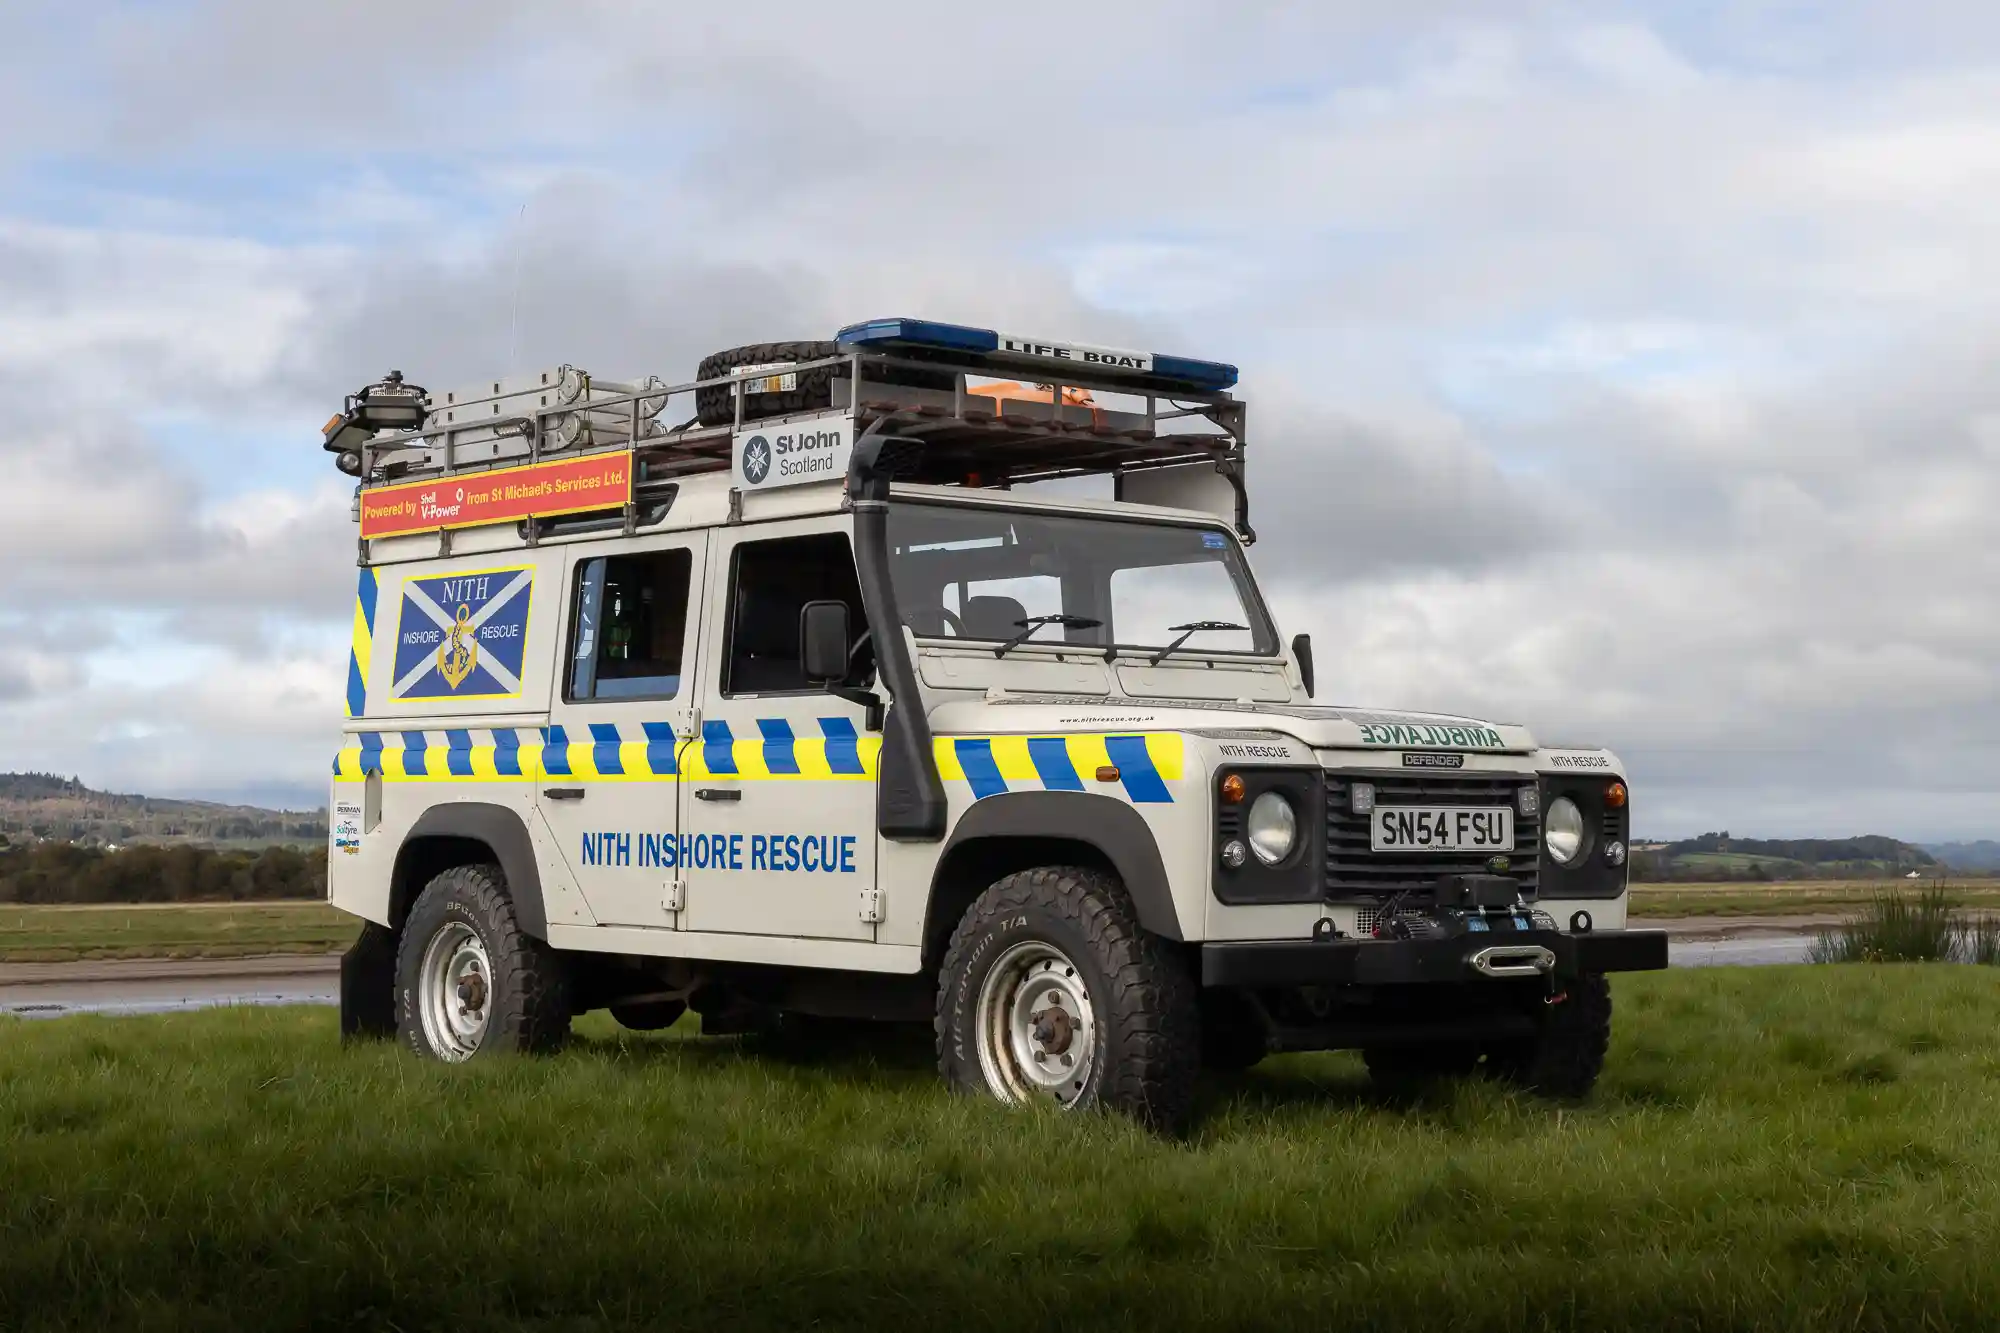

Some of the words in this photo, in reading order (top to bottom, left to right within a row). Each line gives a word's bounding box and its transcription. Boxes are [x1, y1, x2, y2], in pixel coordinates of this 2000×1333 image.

[1005, 340, 1071, 359] LIFE
[1084, 351, 1147, 369] BOAT
[776, 434, 794, 455] St
[796, 430, 841, 453] John
[780, 453, 833, 476] Scotland
[420, 491, 437, 505] Shell
[467, 491, 489, 505] from
[491, 487, 503, 502] St
[504, 480, 553, 501] Michael's
[554, 475, 601, 494] Services
[603, 470, 626, 487] Ltd.
[364, 501, 403, 519] Powered
[405, 500, 417, 517] by
[421, 504, 461, 520] V-Power
[441, 576, 490, 604] NITH
[403, 630, 440, 645] INSHORE
[481, 624, 520, 640] RESCUE
[1059, 715, 1155, 724] www.nithrescue.org.uk
[1218, 744, 1245, 757] NITH
[1245, 745, 1291, 758] RESCUE
[1405, 754, 1461, 767] DEFENDER
[1550, 756, 1574, 767] NITH
[1572, 756, 1609, 767] RESCUE
[1381, 811, 1449, 845] SN54
[1456, 812, 1504, 845] FSU
[581, 831, 631, 867] NITH
[638, 832, 744, 870] INSHORE
[751, 834, 857, 873] RESCUE
[952, 932, 995, 1061] All-Terrain
[1000, 915, 1028, 934] T/A
